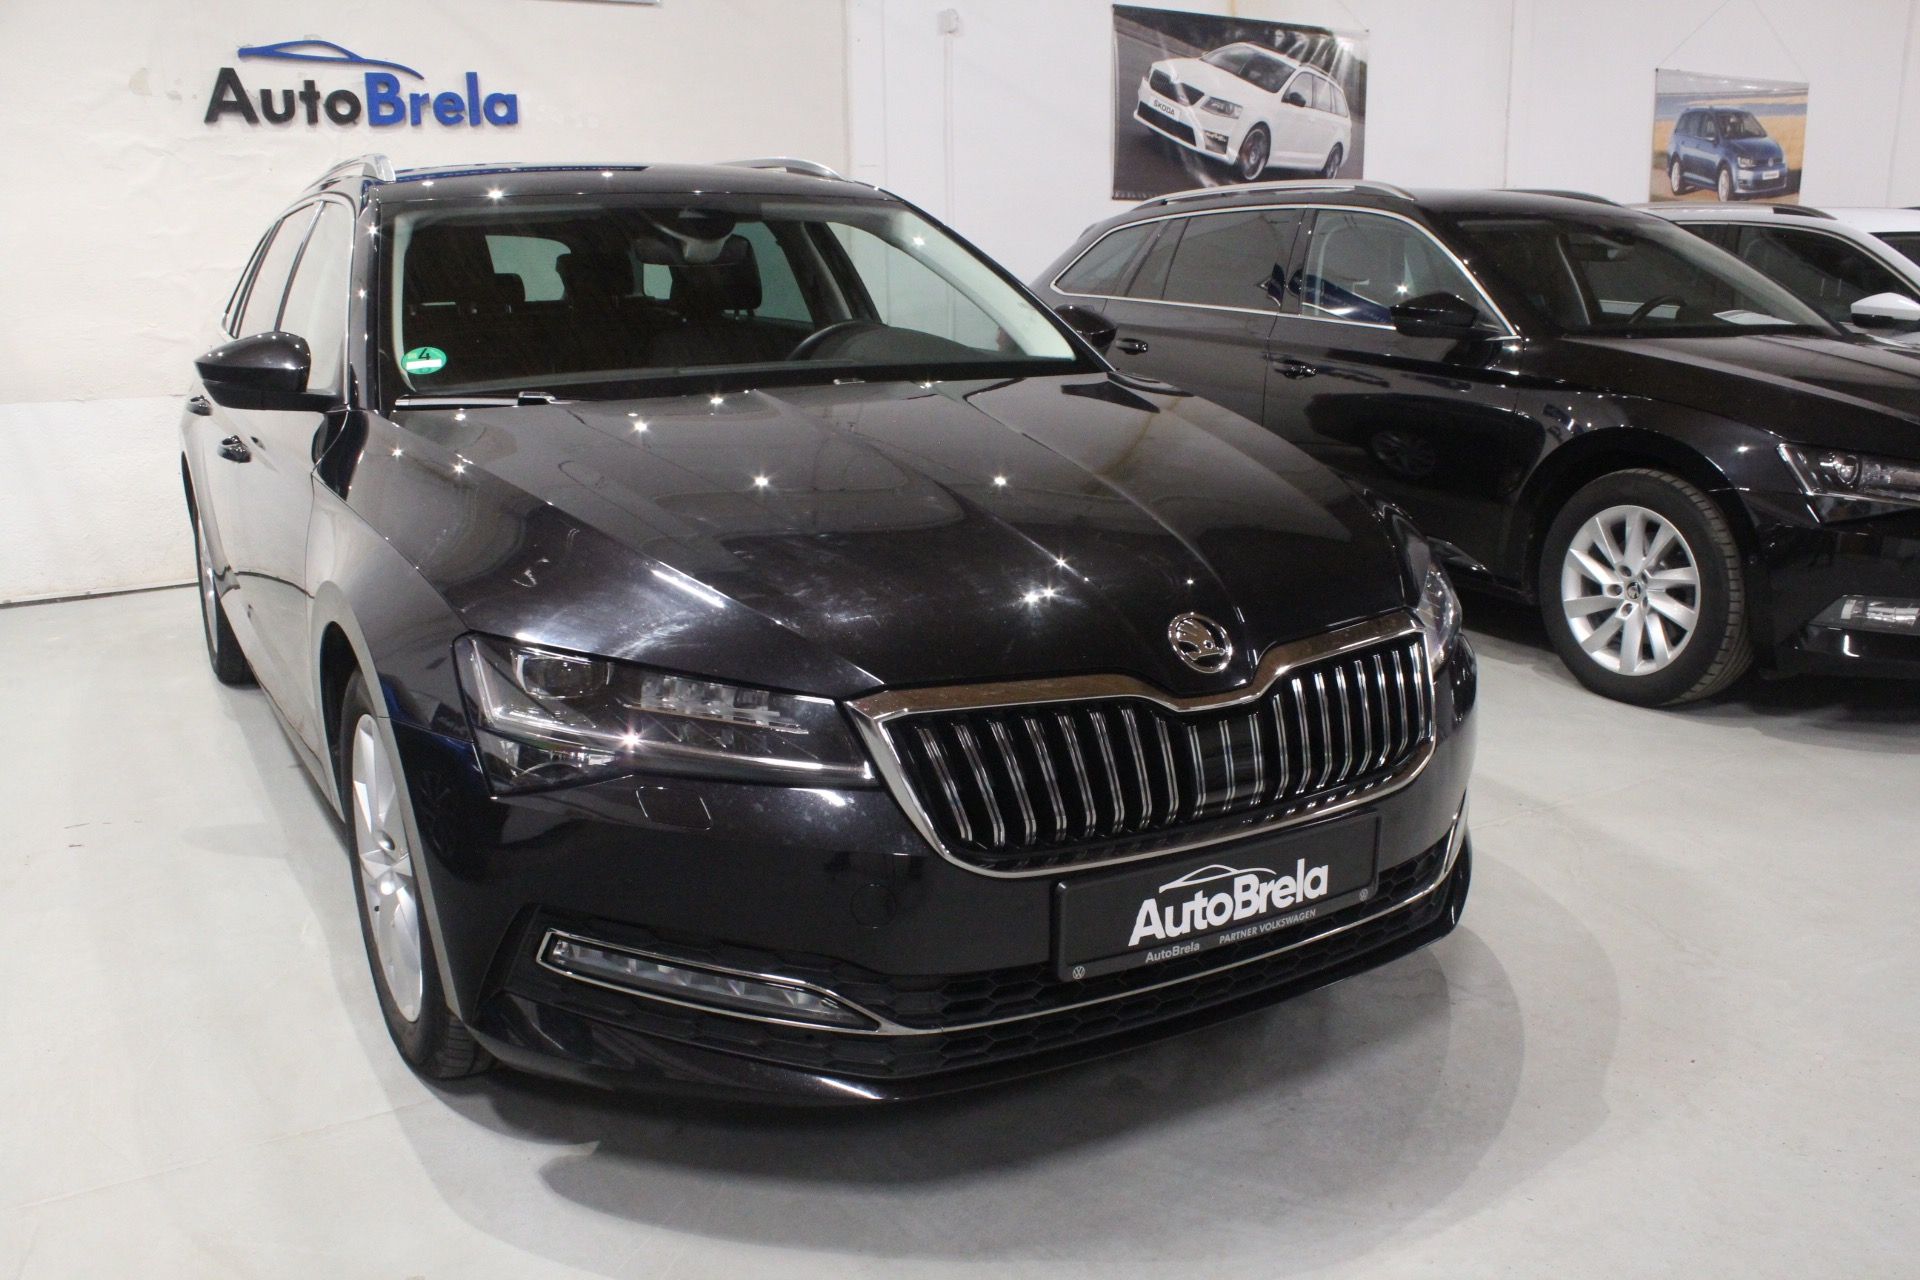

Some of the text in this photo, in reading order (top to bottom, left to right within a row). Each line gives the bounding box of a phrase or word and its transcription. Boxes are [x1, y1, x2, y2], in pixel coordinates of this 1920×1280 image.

[204, 67, 519, 127] AutoBrela
[418, 348, 431, 360] 4
[1128, 858, 1329, 947] AutoBrela
[1145, 909, 1316, 964] AutoBrela PARTNER VOLKSWAGEN
